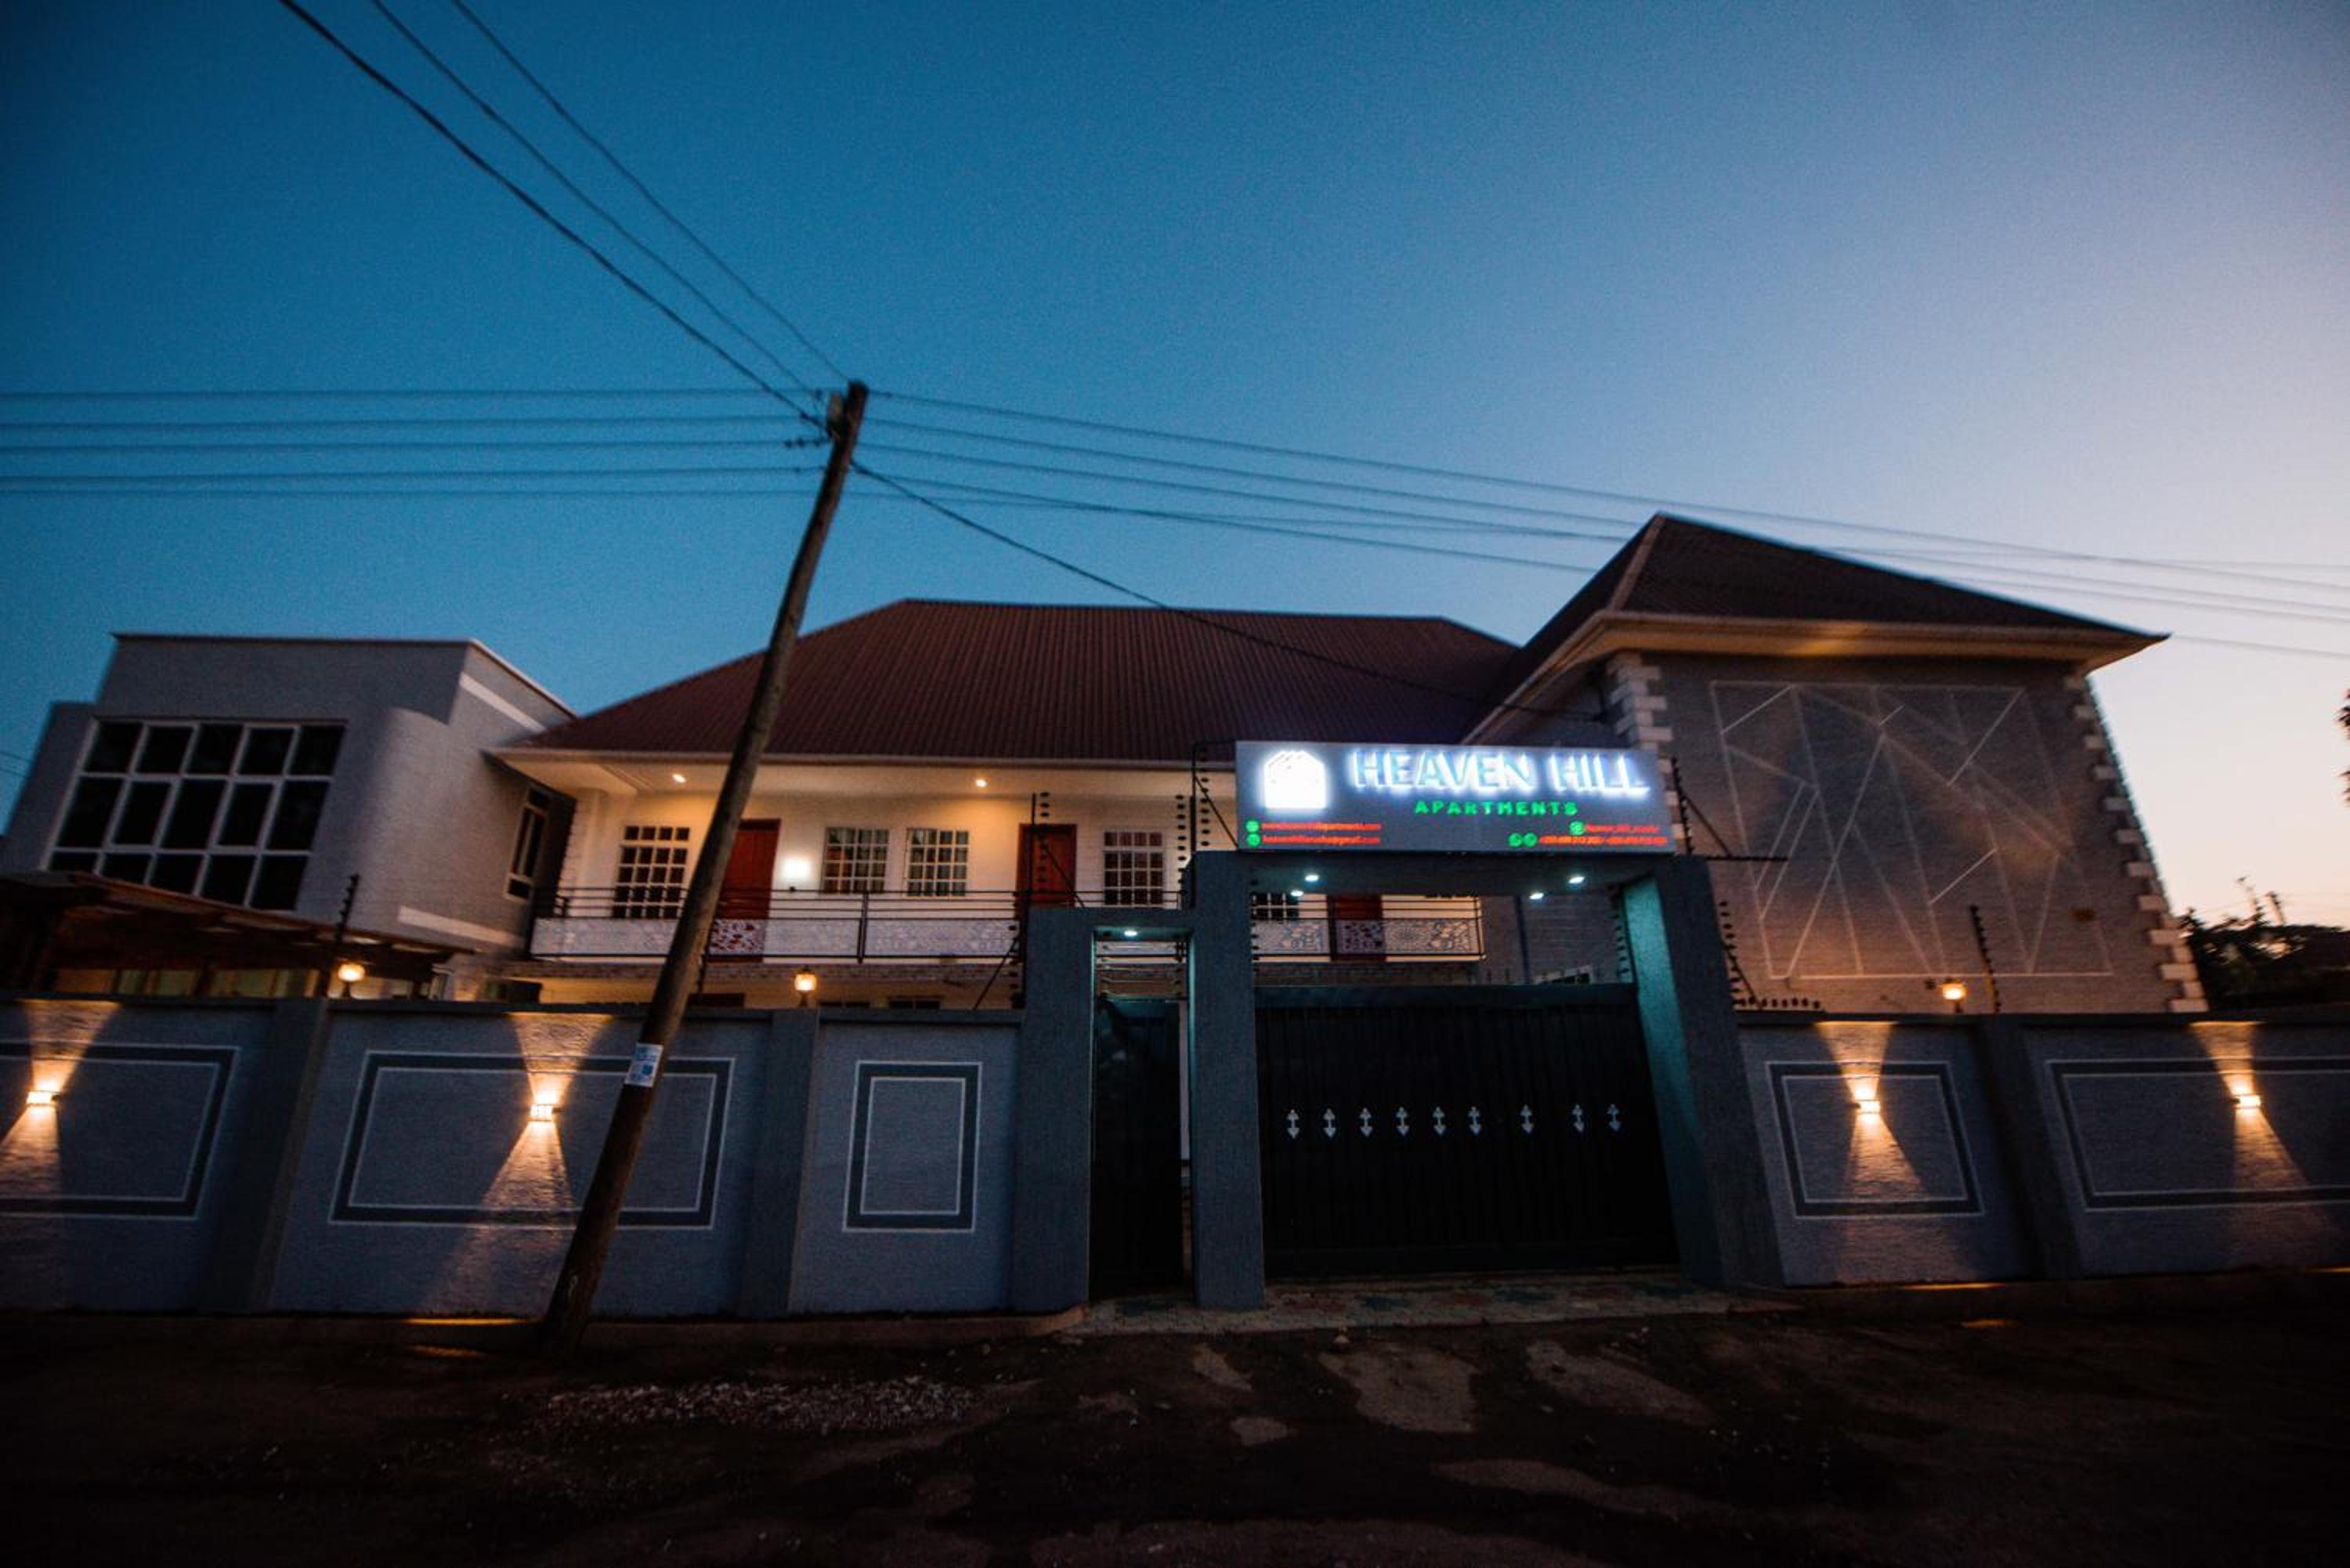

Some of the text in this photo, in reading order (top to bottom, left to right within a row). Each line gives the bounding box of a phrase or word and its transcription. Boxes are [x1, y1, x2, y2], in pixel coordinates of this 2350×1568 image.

[1349, 750, 1651, 794] HEAVEN HILL
[1413, 800, 1578, 816] APARTMENTS
